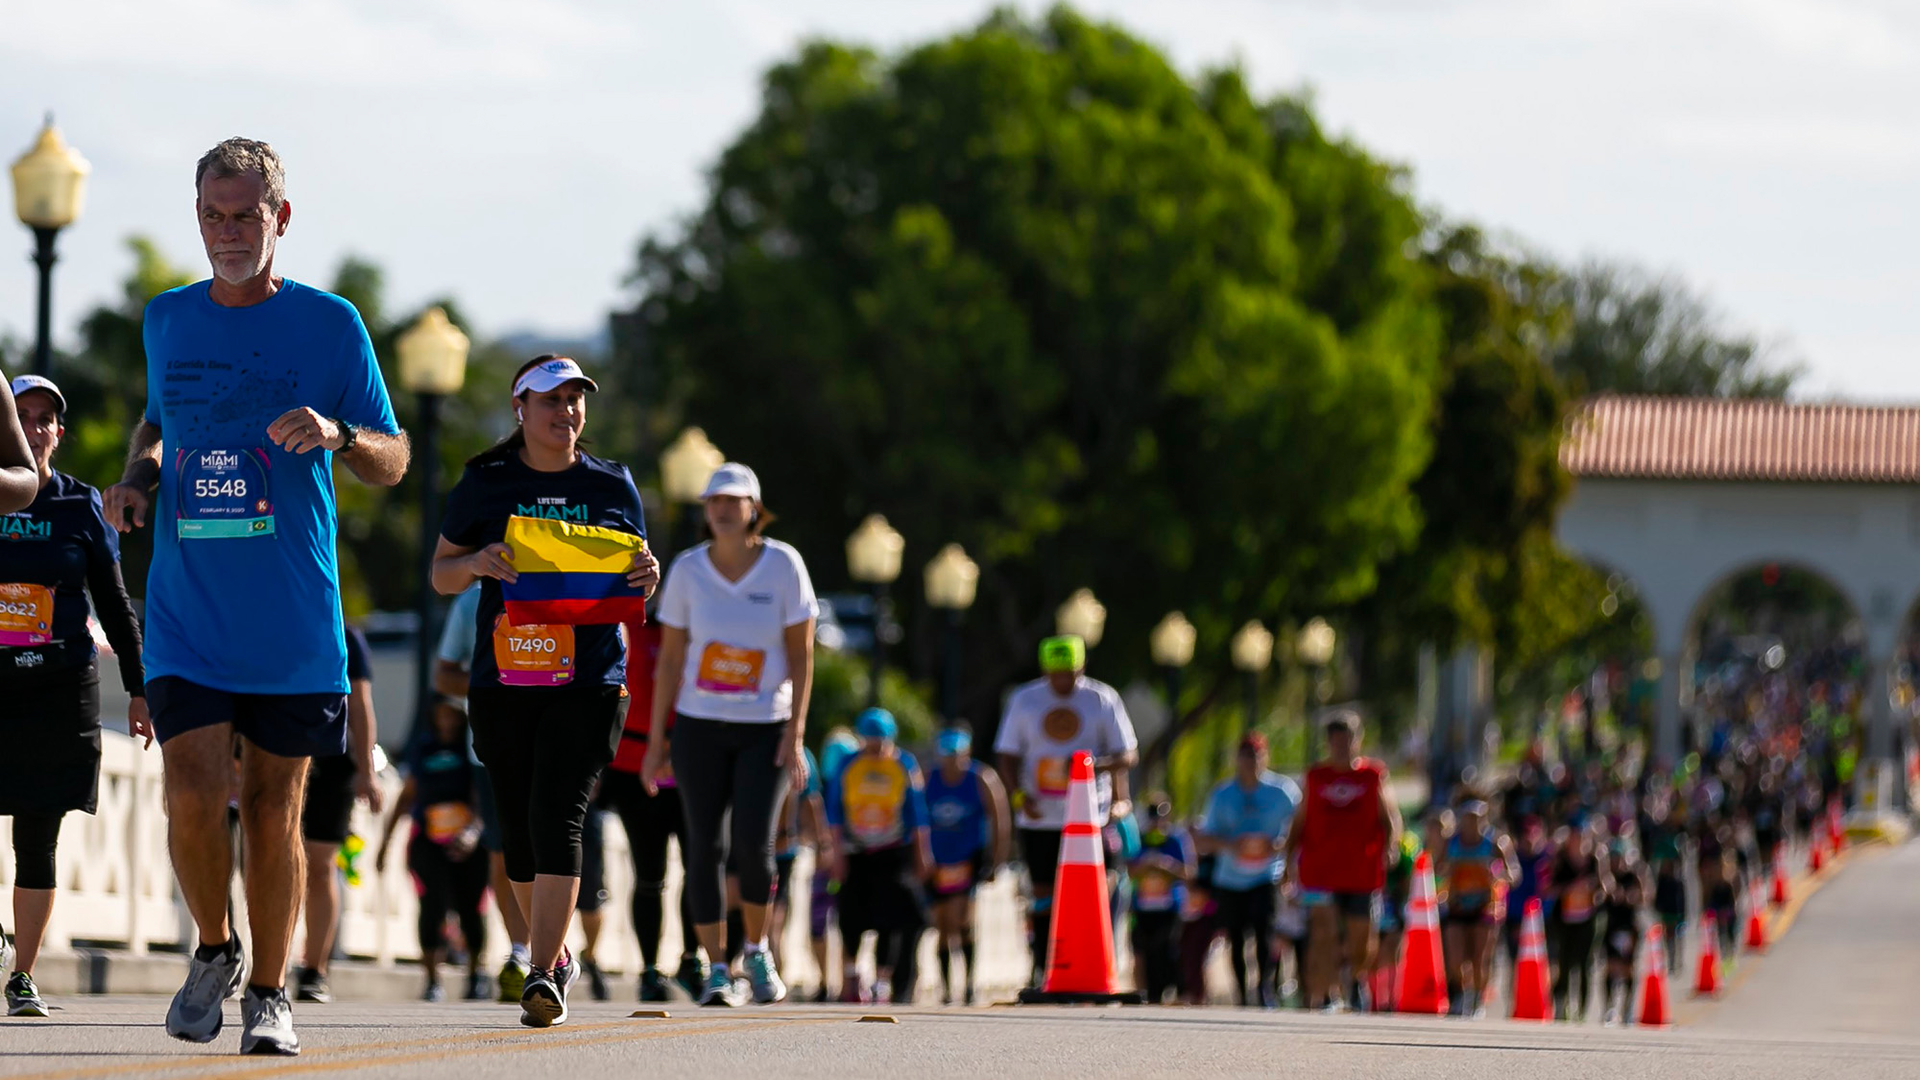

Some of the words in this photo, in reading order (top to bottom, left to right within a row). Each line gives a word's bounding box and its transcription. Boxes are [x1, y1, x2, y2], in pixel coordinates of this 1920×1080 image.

[201, 454, 238, 466] MIAMI
[195, 479, 247, 497] 5548
[517, 503, 588, 520] MIAMI
[0, 517, 52, 537] IAMI
[508, 637, 557, 653] 17490
